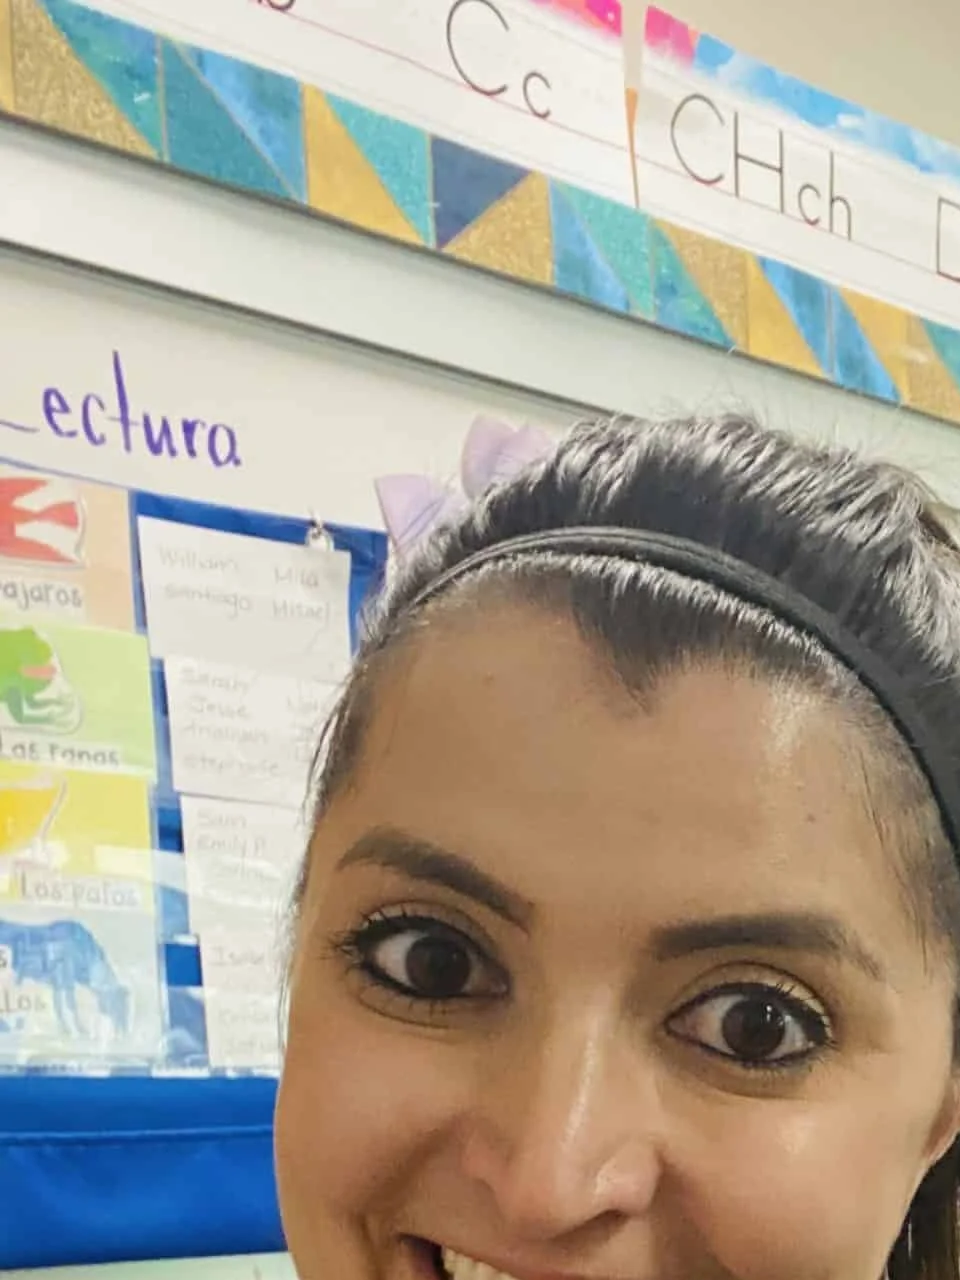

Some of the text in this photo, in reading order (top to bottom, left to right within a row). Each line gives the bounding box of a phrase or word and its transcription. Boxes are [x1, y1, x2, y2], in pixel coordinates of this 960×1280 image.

[671, 94, 852, 240] CHch
[0, 579, 83, 612] ajaros
[0, 733, 40, 762] as
